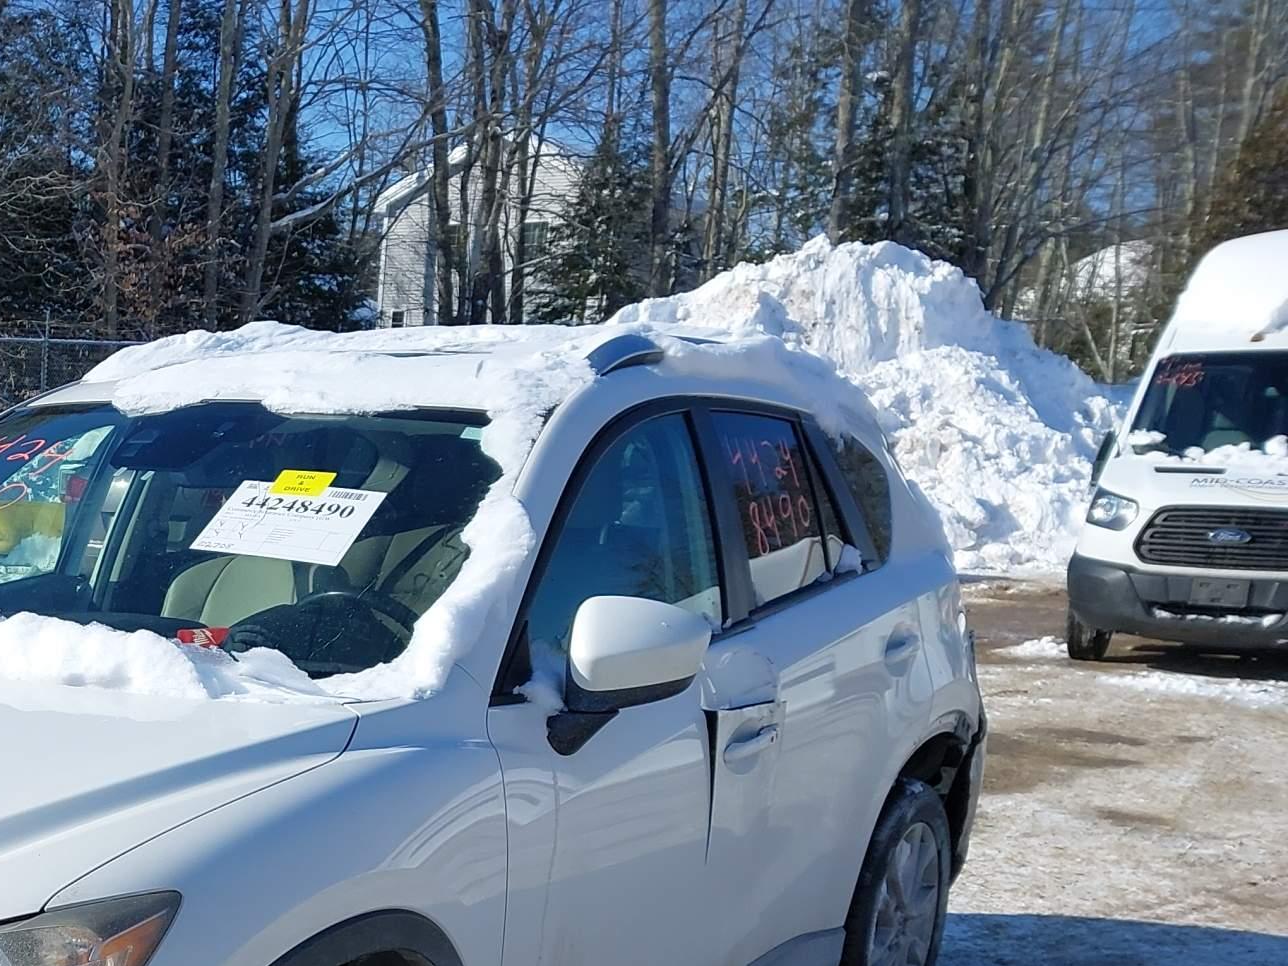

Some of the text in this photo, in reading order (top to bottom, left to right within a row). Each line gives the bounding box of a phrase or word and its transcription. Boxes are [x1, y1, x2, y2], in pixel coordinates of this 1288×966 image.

[283, 485, 311, 493] DRIVE
[241, 494, 356, 519] 44248490
[749, 492, 811, 556] 8490
